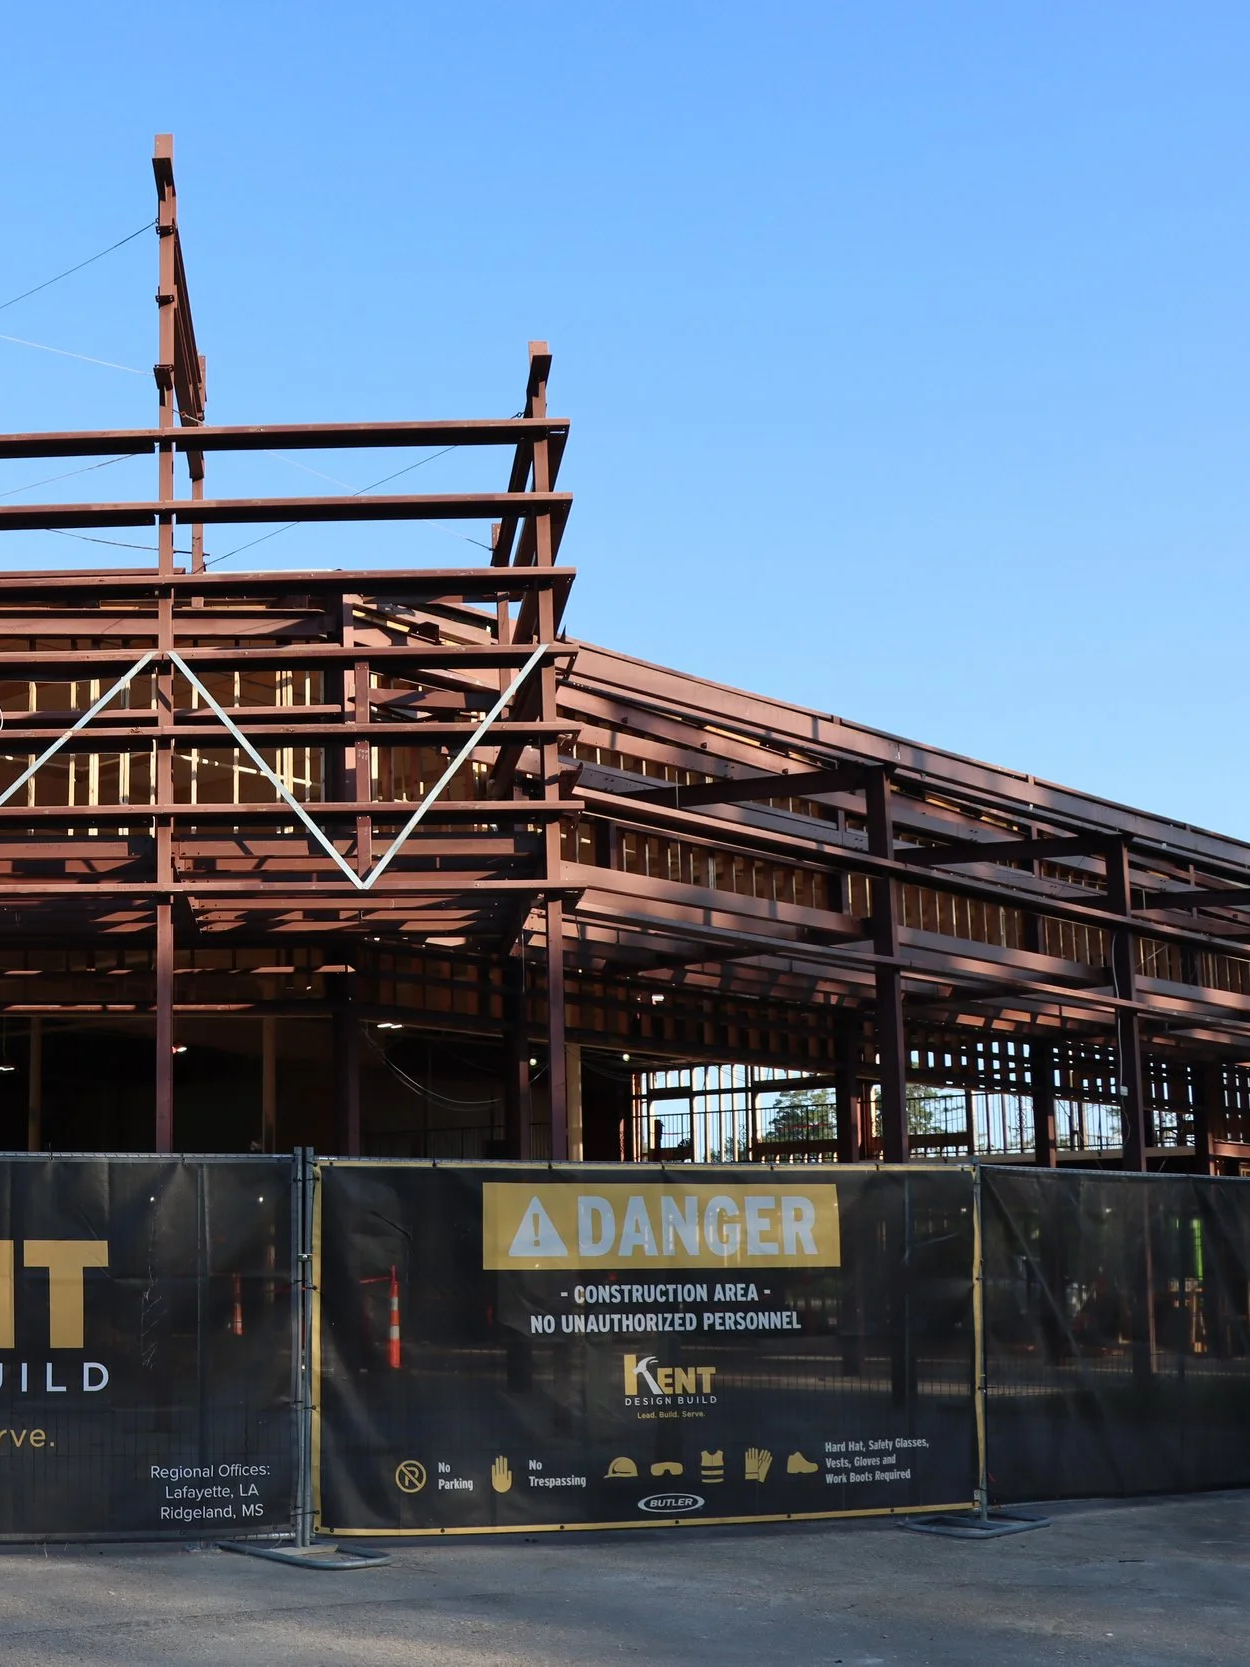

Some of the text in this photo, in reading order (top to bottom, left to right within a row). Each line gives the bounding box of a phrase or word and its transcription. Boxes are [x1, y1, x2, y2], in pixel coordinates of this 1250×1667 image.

[577, 1195, 818, 1257] DANGER
[574, 1284, 707, 1304] CONSTRUCTION
[713, 1283, 759, 1302] AREA
[530, 1311, 801, 1334] NO UNAUTHORIZED PERSONNEL
[624, 1354, 716, 1395] KENT
[625, 1396, 717, 1406] DESIGN BUILD
[637, 1410, 705, 1419] Lead. Build. Serve.
[825, 1438, 930, 1453] Hard Hat, Safety Glasses,
[438, 1461, 450, 1473] No
[529, 1459, 542, 1471] No
[825, 1454, 896, 1469] Vests, Gloves and
[150, 1463, 271, 1481] Regional Offices:
[826, 1469, 911, 1484] Work Boots Required
[438, 1478, 474, 1491] Parking
[529, 1474, 587, 1488] Trespassing
[165, 1483, 259, 1501] Lafayette, LA
[650, 1498, 693, 1507] BUTLER
[160, 1503, 264, 1522] Ridgeland, MS
